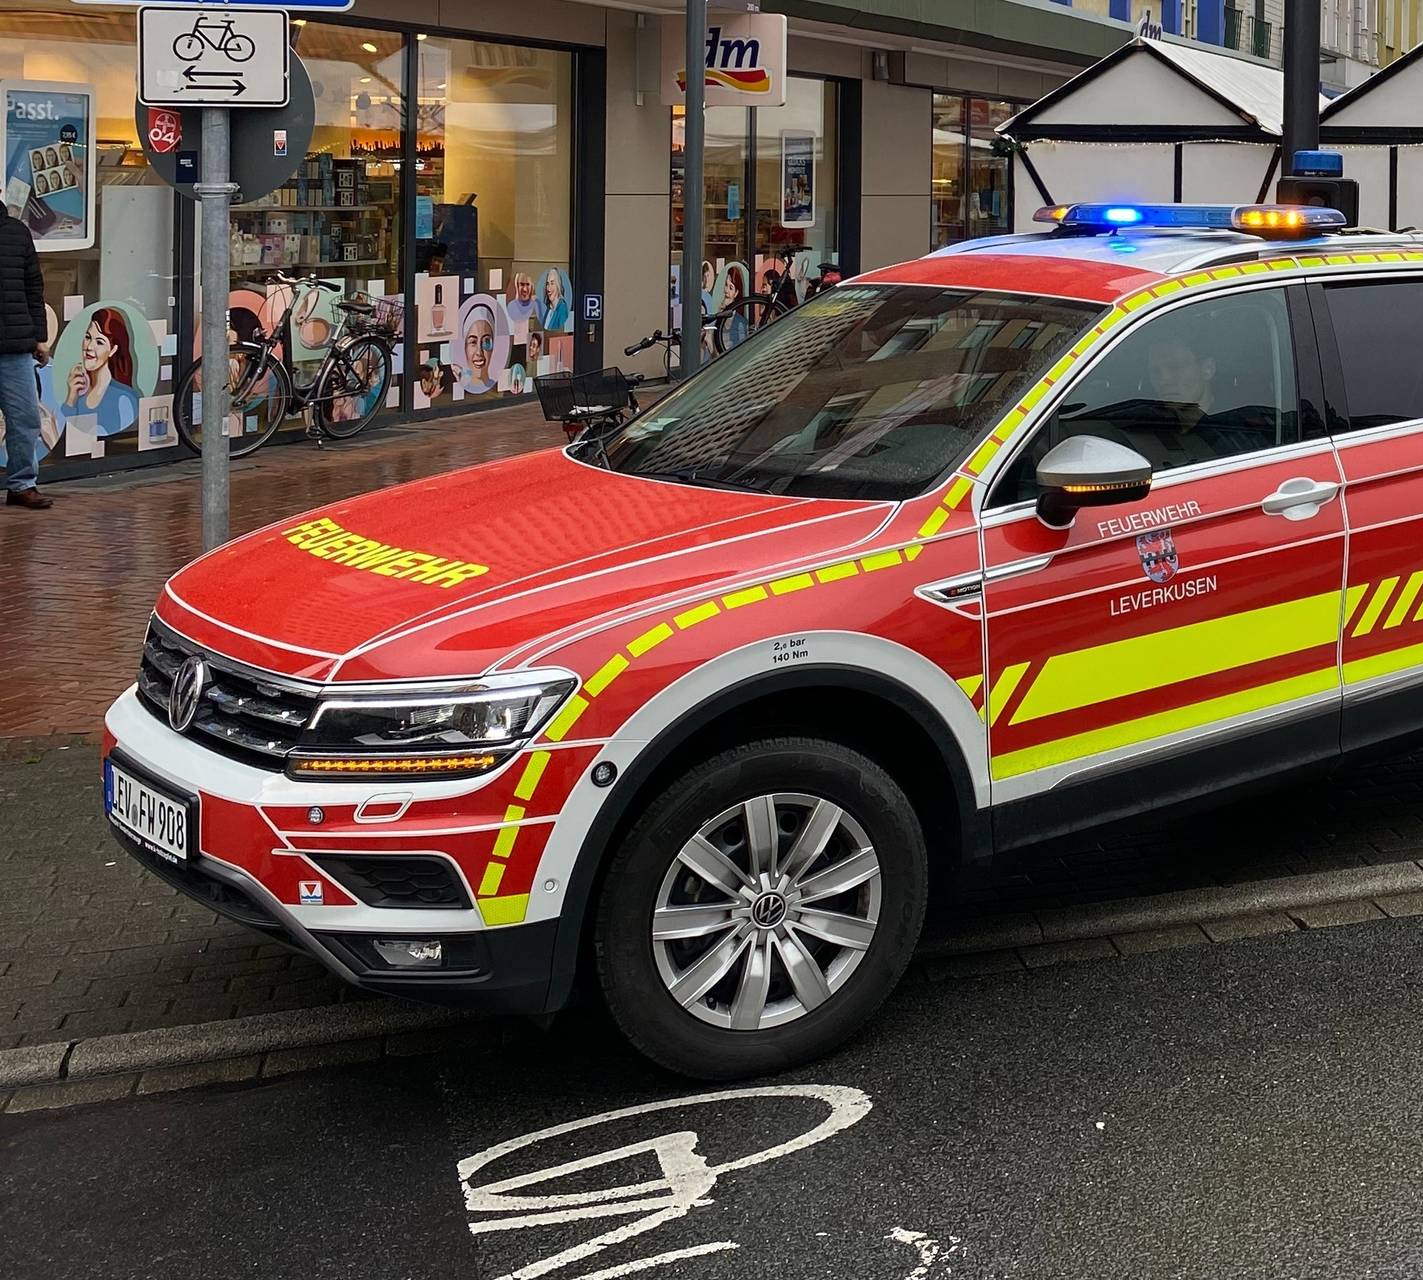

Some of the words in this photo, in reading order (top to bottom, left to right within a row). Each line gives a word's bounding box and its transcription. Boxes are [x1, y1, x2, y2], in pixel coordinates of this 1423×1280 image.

[705, 26, 760, 68] dm
[150, 128, 175, 144] 04
[1097, 500, 1202, 538] FEUERWEHR
[281, 517, 490, 589] FEUERWEHR
[1110, 575, 1217, 616] LEVERKUSEN
[772, 652, 790, 663] 140
[792, 650, 809, 659] Nm
[790, 638, 806, 648] bar
[158, 801, 184, 851] 908
